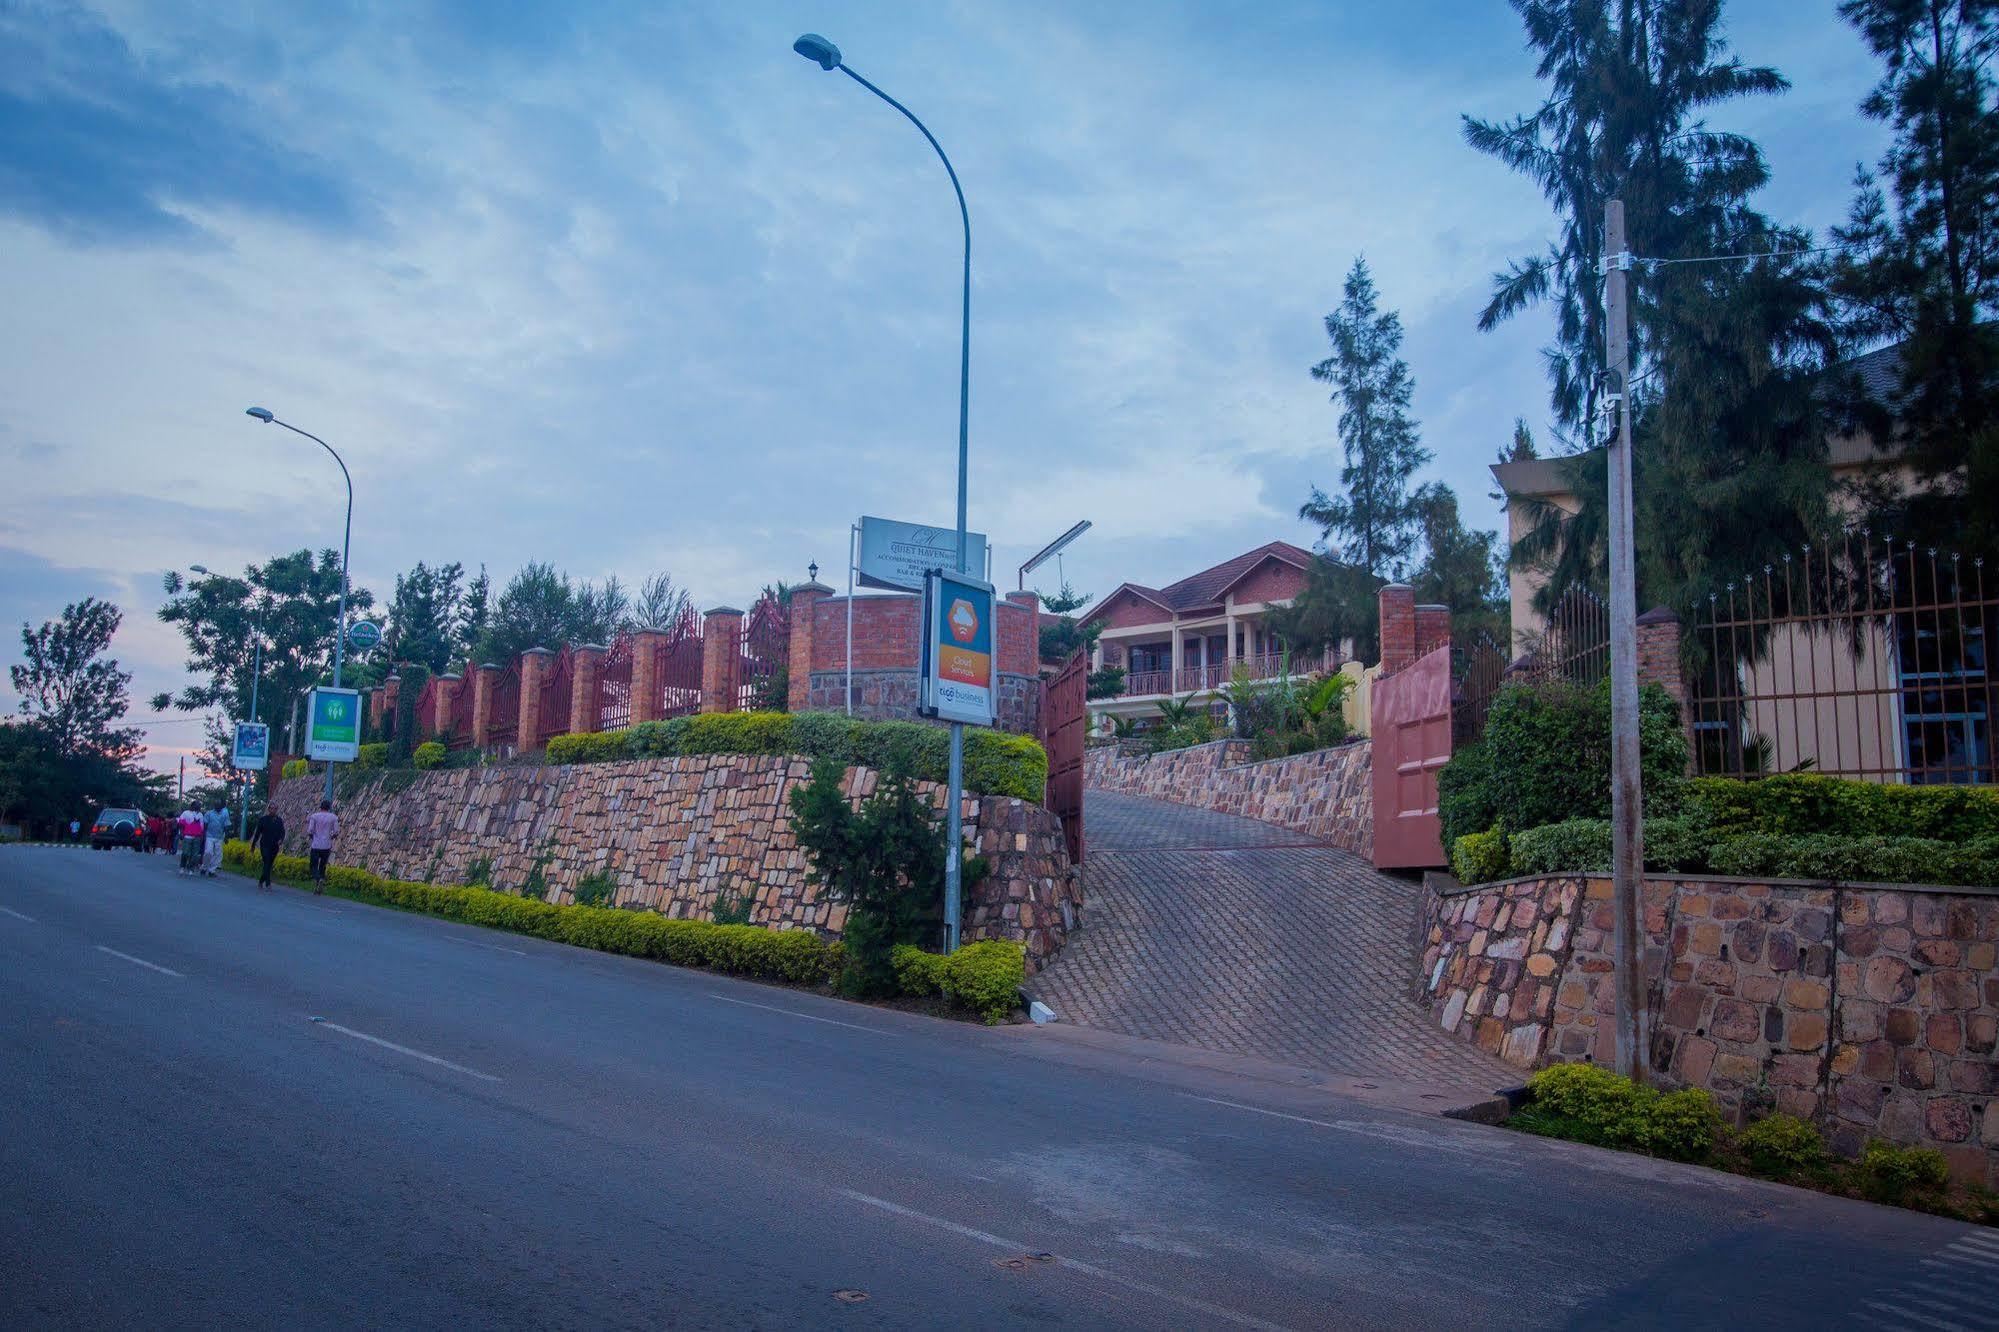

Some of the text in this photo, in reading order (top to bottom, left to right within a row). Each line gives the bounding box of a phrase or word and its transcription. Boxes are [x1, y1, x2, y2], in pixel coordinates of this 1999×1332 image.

[891, 543, 917, 554] QUIET
[918, 548, 945, 559] HAVEN
[954, 656, 972, 667] Cloud
[951, 665, 974, 677] Services
[939, 687, 984, 704] tigo business
